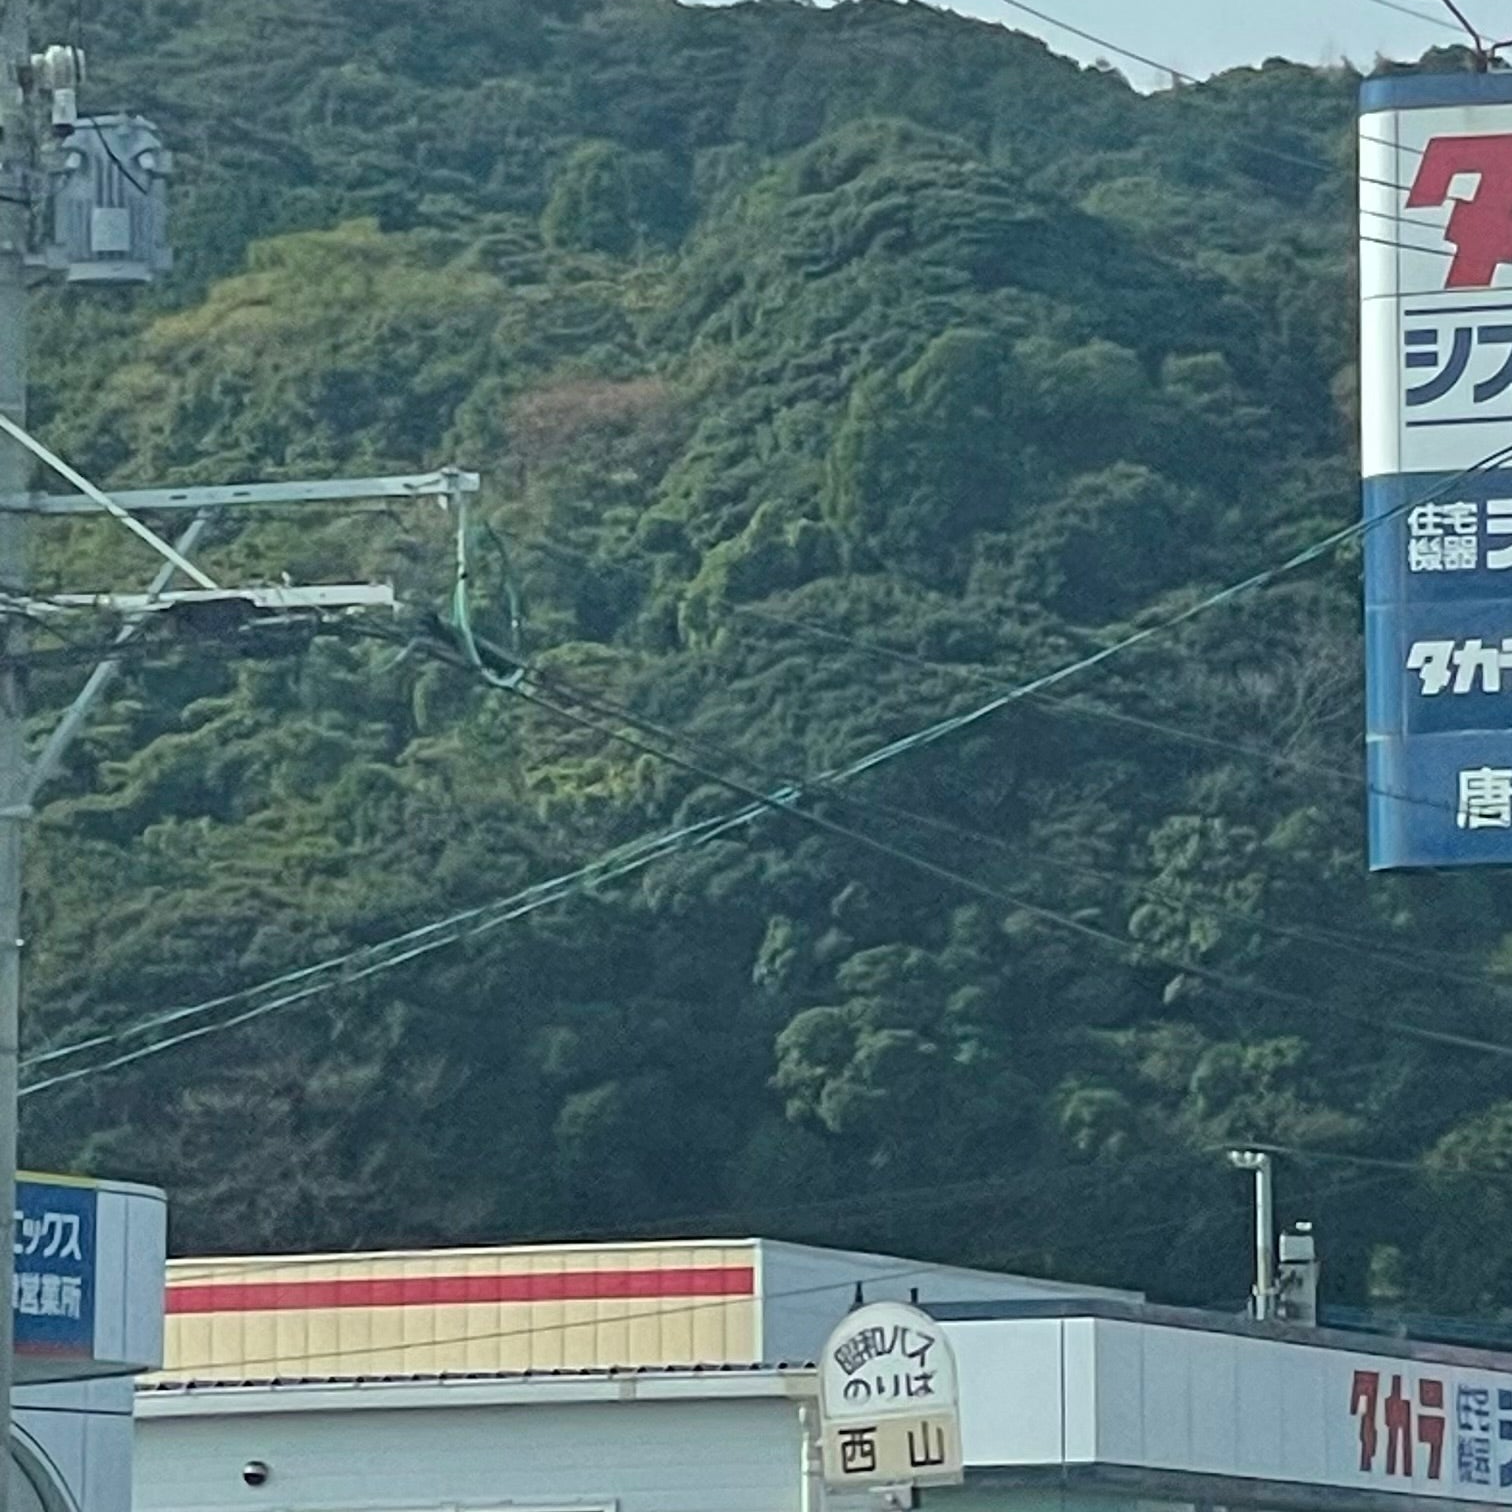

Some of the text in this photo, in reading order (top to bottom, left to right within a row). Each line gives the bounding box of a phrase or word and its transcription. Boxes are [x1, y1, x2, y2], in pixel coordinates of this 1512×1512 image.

[12, 1273, 82, 1319] 営業所
[838, 1420, 945, 1474] 西山
[1350, 1370, 1445, 1479] タカラ
